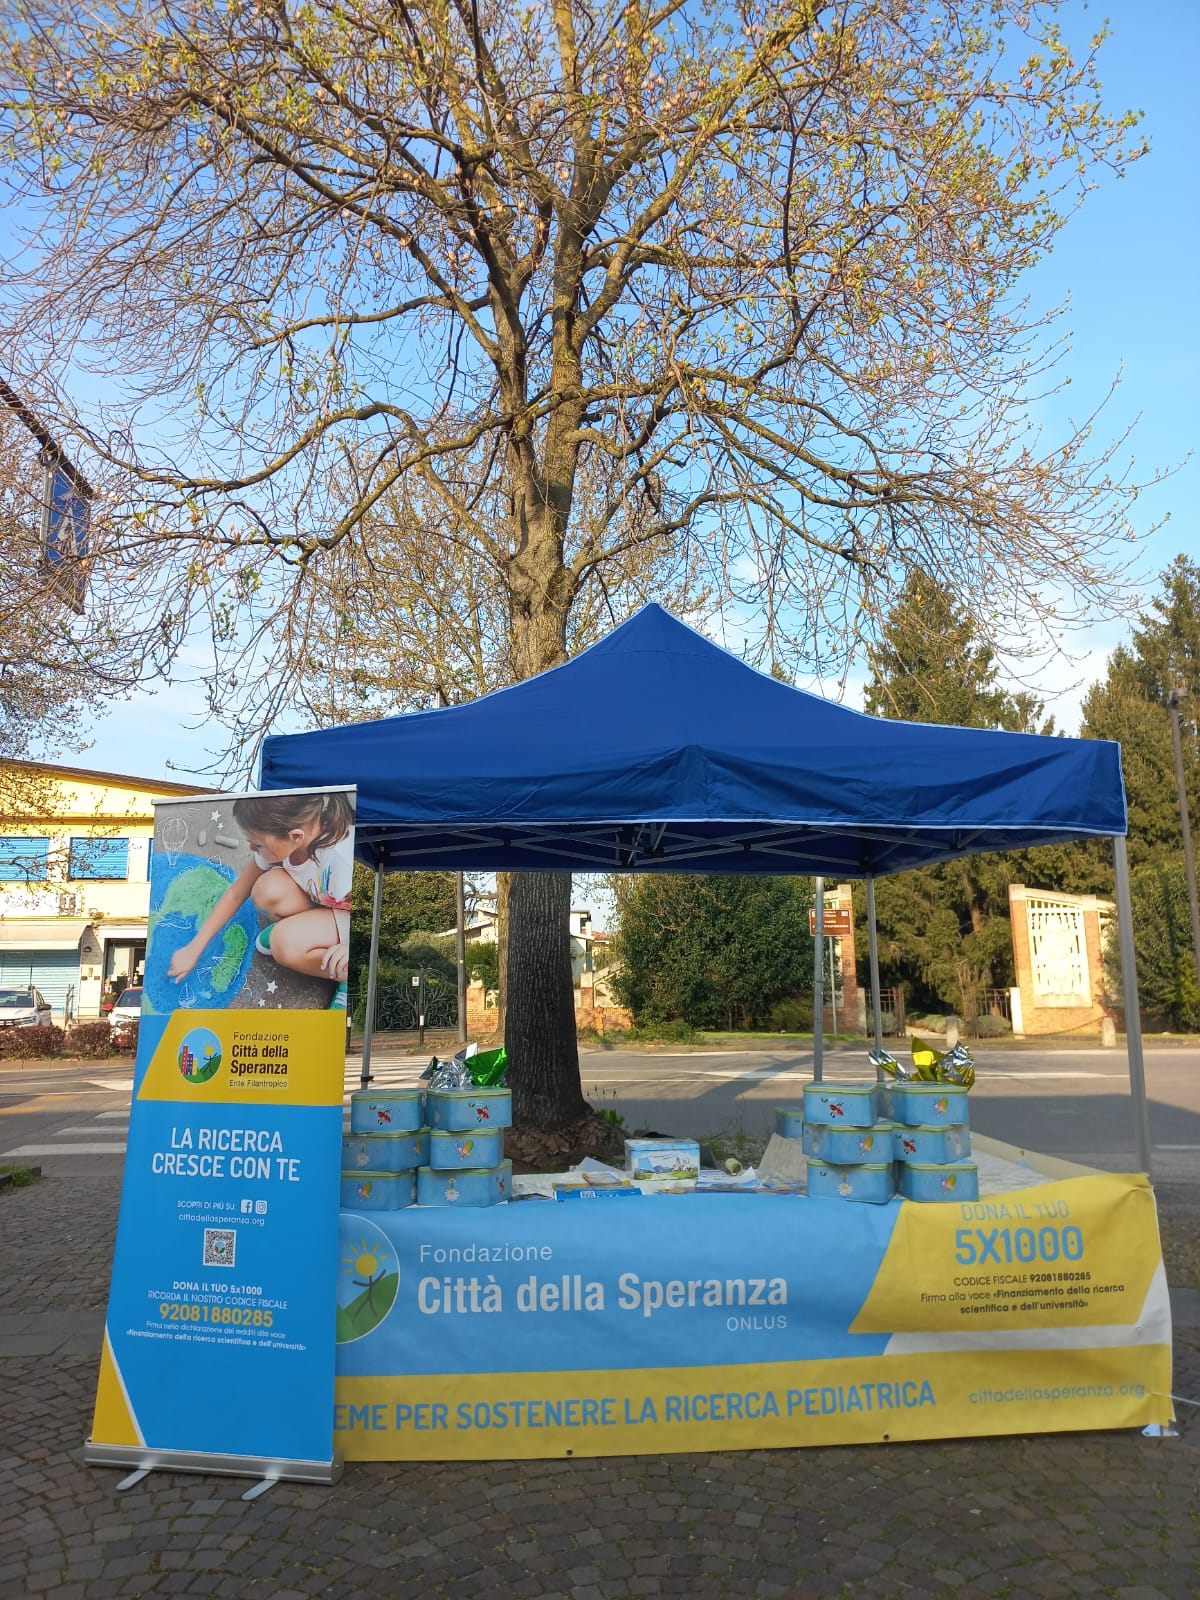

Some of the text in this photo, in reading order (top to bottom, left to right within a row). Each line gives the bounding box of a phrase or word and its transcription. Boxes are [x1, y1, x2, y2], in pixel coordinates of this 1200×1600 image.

[233, 1031, 290, 1042] Fondazione
[232, 1044, 289, 1058] Città della
[230, 1059, 288, 1077] Speranza
[229, 1079, 288, 1089] Ente Filantropico
[171, 1127, 283, 1153] LA RICERCA
[151, 1153, 301, 1182] CRESCE CON TE
[177, 1200, 203, 1209] SCOPRI
[961, 1200, 1070, 1222] DONA IL TUO
[178, 1213, 265, 1227] cittadellasperanza.org
[419, 1242, 553, 1264] Fondazione
[954, 1226, 1085, 1266] 5X1000
[172, 1281, 263, 1296] DONA IL TUO 5x1000
[953, 1271, 1092, 1287] CODICE FISCALE 92081880285
[147, 1290, 288, 1310] RICORDA IL NOSTRO CODICE FISCALE
[418, 1272, 789, 1318] Città della Speranza
[920, 1292, 946, 1303] Firma
[948, 1291, 966, 1301] alla
[968, 1290, 991, 1300] voce
[1066, 1284, 1090, 1295] della
[1092, 1283, 1125, 1293] ricerca
[159, 1303, 273, 1327] 92081880285
[960, 1302, 1009, 1315] scientifica
[1011, 1304, 1018, 1312] e
[726, 1315, 788, 1332] ONLUS
[174, 1333, 192, 1341] della
[968, 1384, 1146, 1405] cittadellasperanza.org
[395, 1403, 449, 1430] PER
[455, 1399, 617, 1430] SOSTENERE
[623, 1397, 657, 1424] LA
[665, 1391, 780, 1422] RICERCA
[786, 1379, 936, 1416] PEDIATRICA
